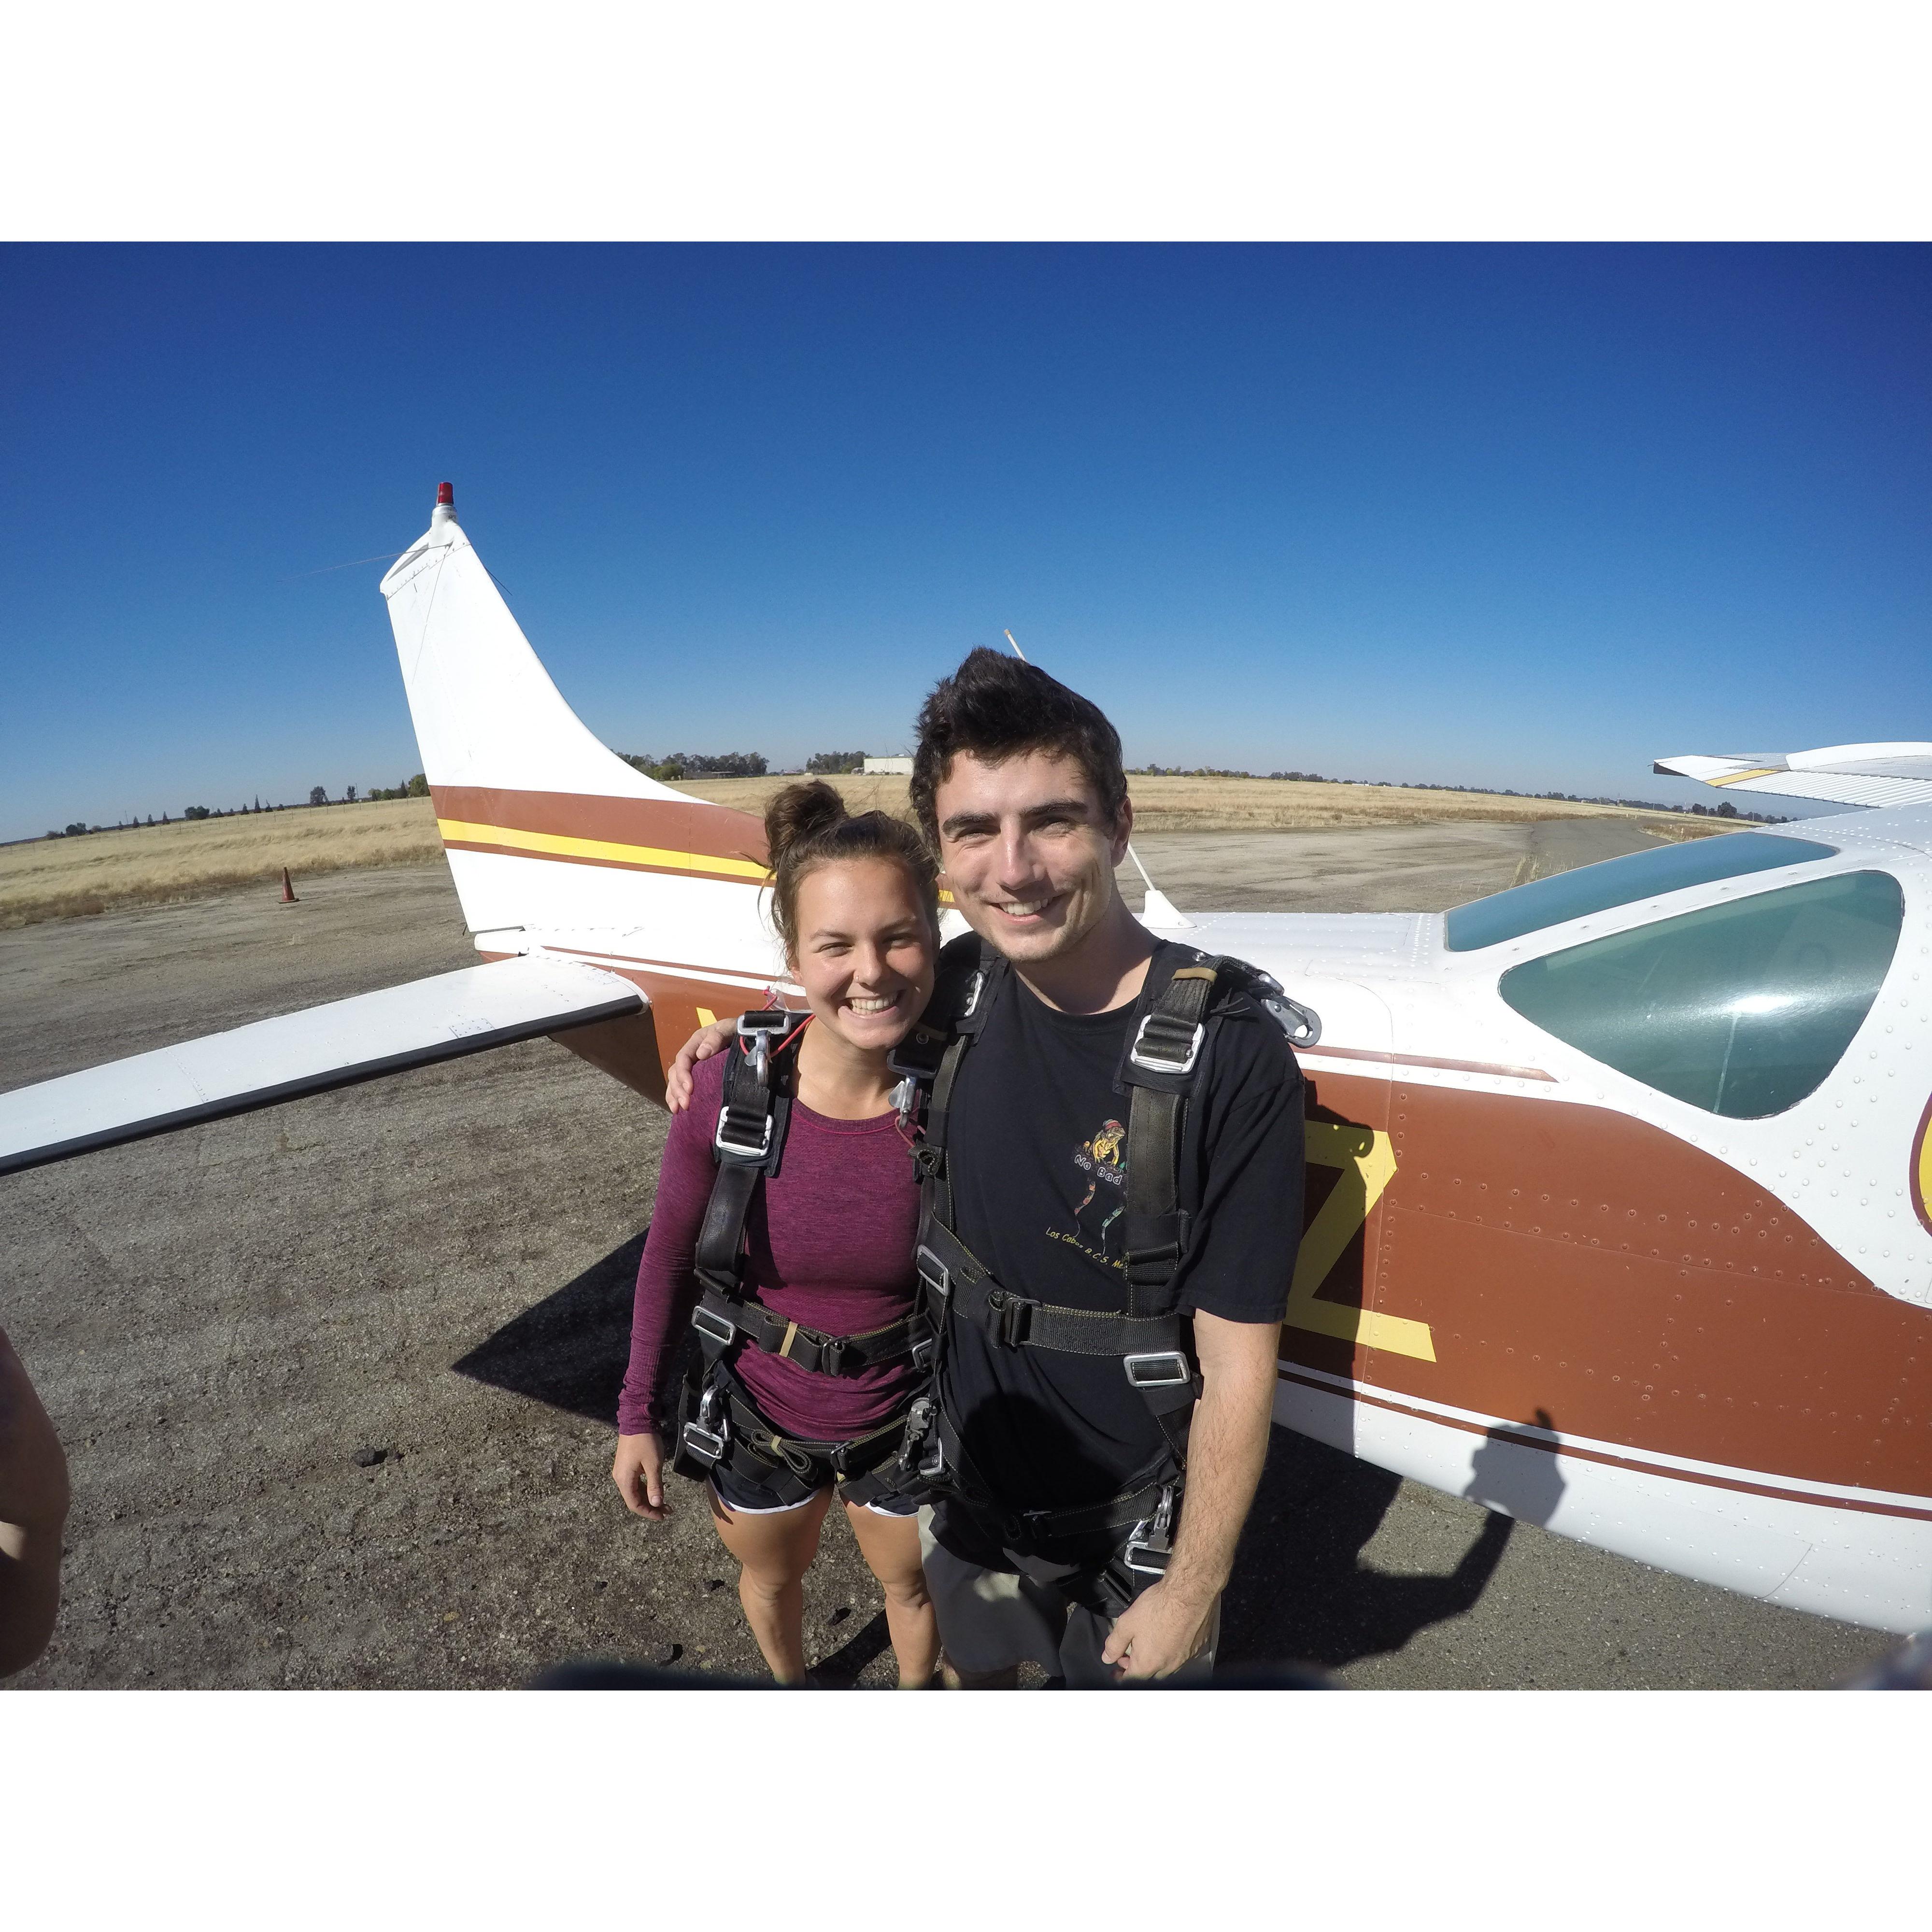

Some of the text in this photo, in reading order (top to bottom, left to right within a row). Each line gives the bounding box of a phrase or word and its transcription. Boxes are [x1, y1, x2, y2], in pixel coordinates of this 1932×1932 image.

[1074, 1154, 1122, 1185] No Bad
[1046, 1226, 1060, 1239] Los
[1062, 1234, 1083, 1248] Cabos
